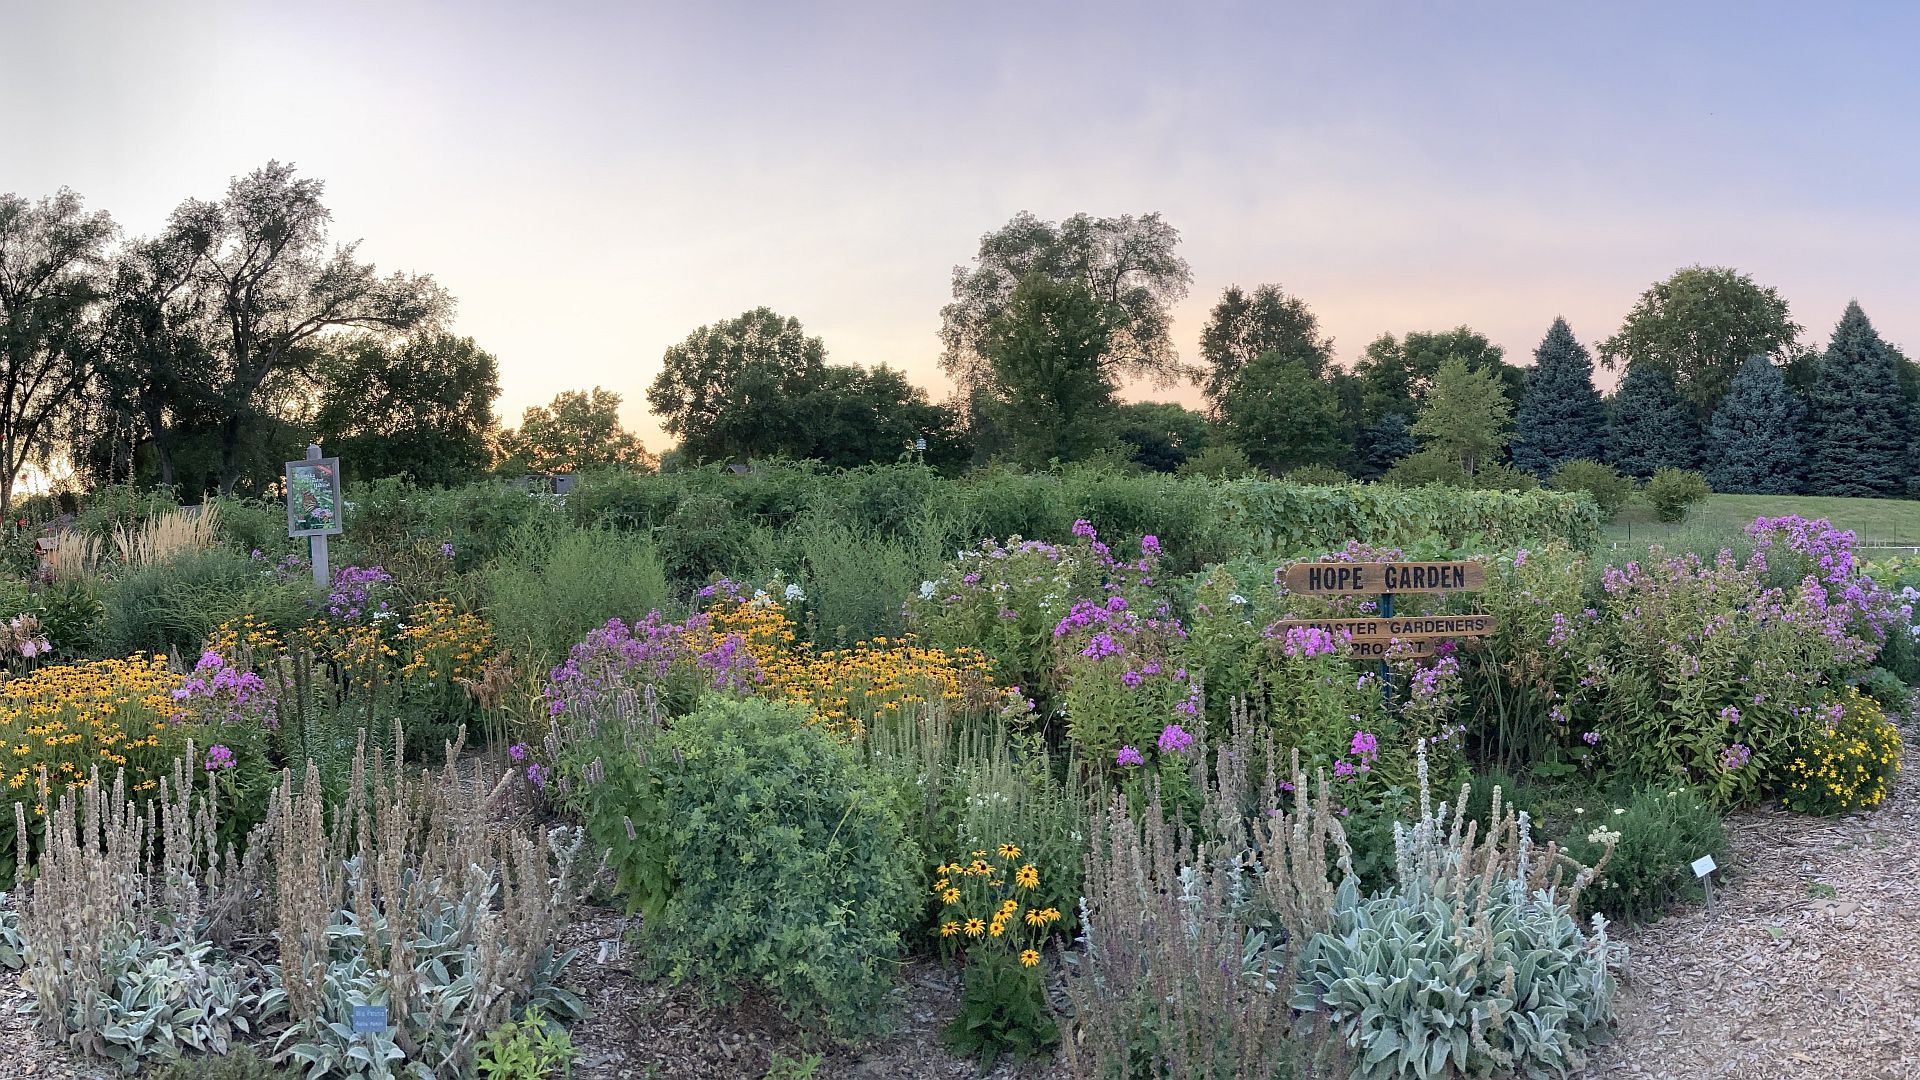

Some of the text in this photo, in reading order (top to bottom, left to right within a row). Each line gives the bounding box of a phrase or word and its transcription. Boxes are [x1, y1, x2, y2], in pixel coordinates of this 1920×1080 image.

[1309, 565, 1465, 590] HOPE GARDEN
[1351, 641, 1425, 655] PROT
